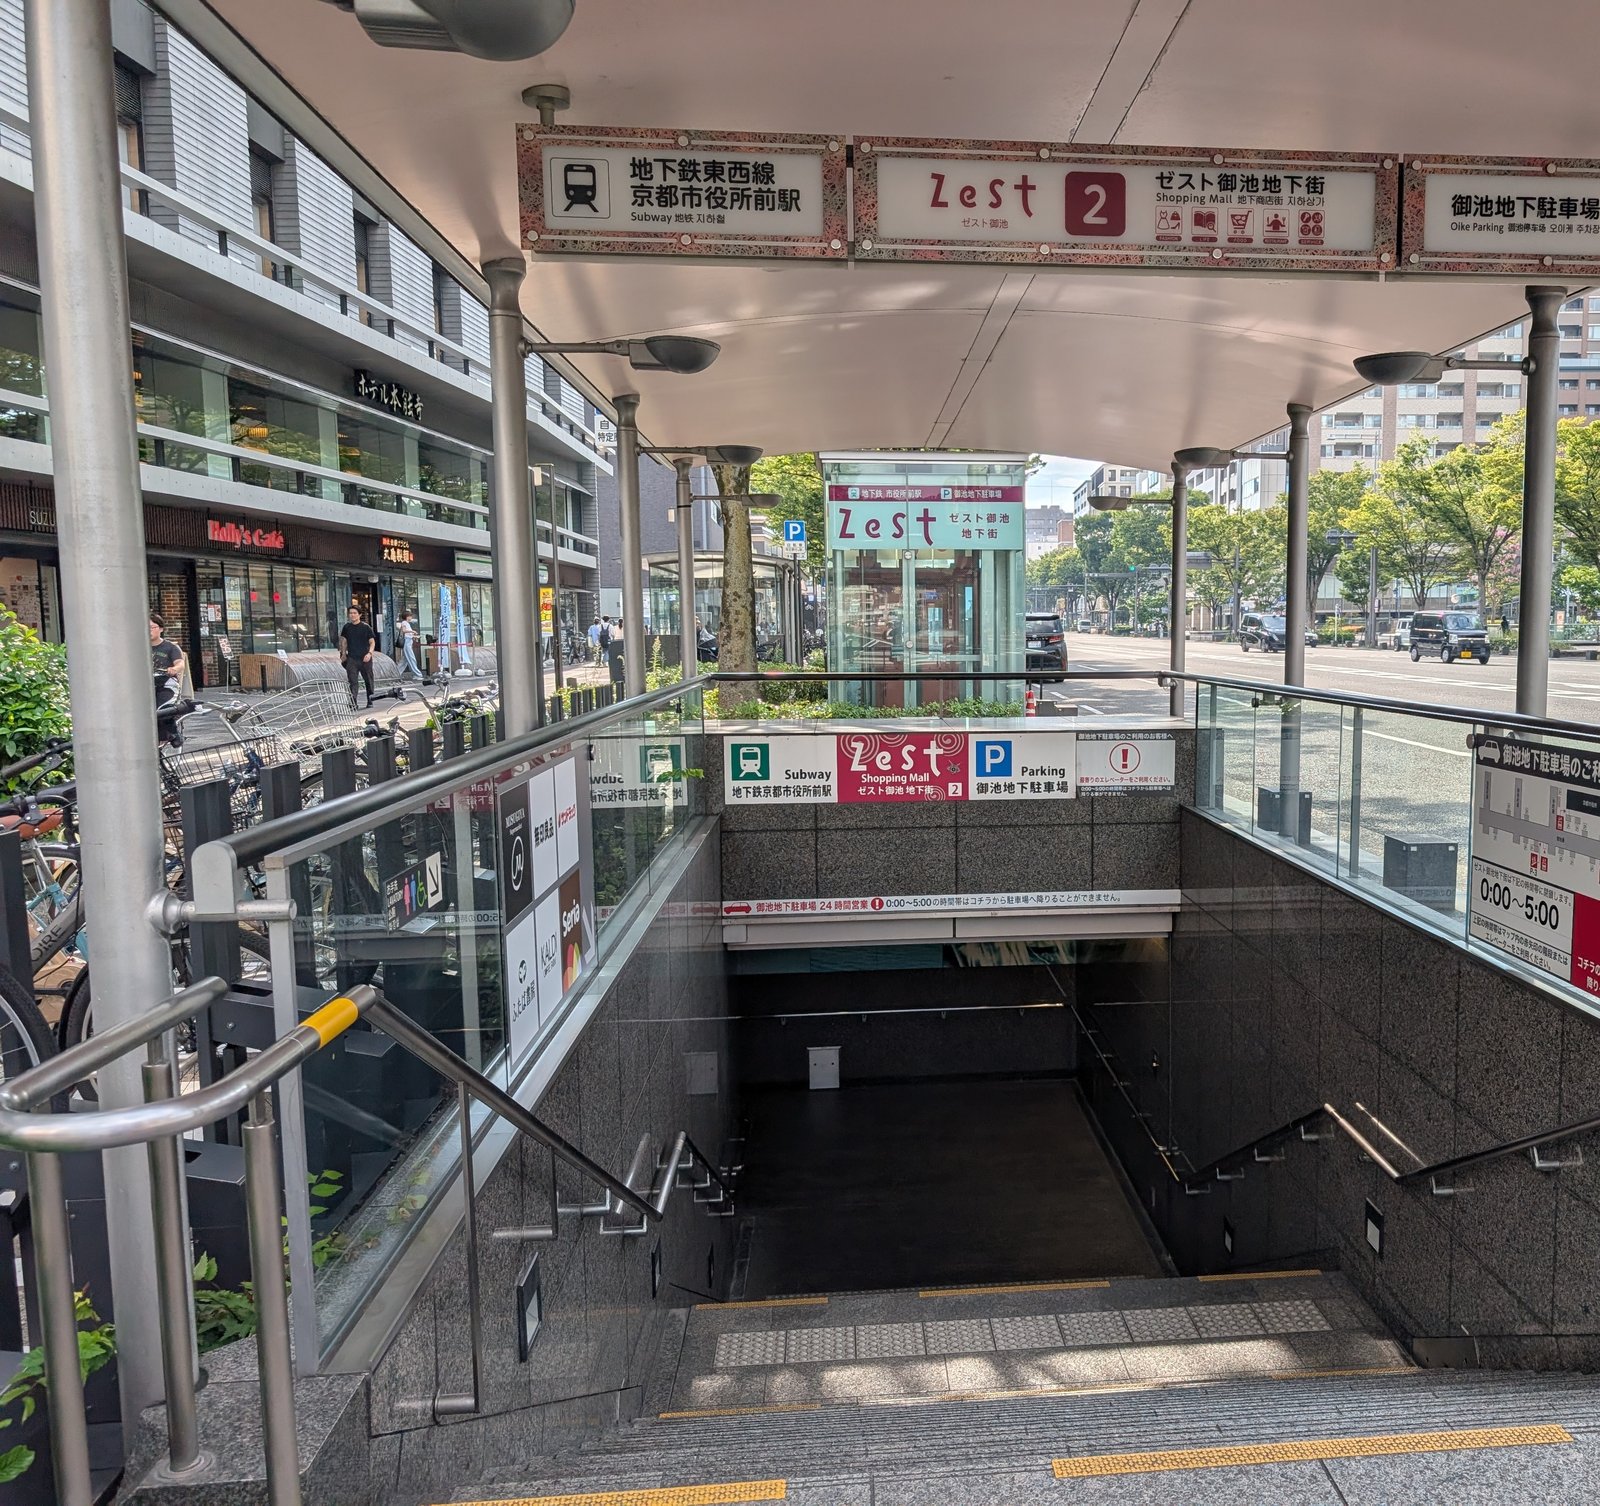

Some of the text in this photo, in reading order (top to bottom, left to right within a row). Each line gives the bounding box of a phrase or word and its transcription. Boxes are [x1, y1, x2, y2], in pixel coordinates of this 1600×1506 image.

[629, 156, 775, 185] 地下鉄東西線
[1155, 171, 1325, 195] ゼスト御池地下街
[630, 184, 801, 213] 京都市役所前駅
[930, 172, 1036, 218] Zest
[1156, 192, 1206, 205] Shopping
[1209, 194, 1233, 205] Mall
[1083, 184, 1108, 225] 2
[1451, 194, 1600, 220] 御池地下駐車場
[630, 211, 672, 224] Subway
[696, 213, 726, 225] 지하철
[961, 218, 1009, 229] ゼスト御池
[1450, 222, 1471, 232] Oike
[1473, 222, 1504, 234] Parking
[861, 489, 883, 498] 地下鉄
[949, 513, 1010, 524] ゼスト御池
[207, 520, 252, 548] Holly's
[839, 508, 937, 547] Zest
[961, 528, 999, 539] 地下街
[850, 740, 944, 777] Zest
[784, 769, 832, 782] Subway
[861, 772, 929, 784] Shopping Mall
[1021, 766, 1066, 778] Parking
[732, 785, 832, 799] 地下鉄京都市役所前駅
[857, 786, 904, 796] ゼスト御池
[951, 784, 960, 795] 2
[976, 781, 1069, 795] 御池地下駐車場
[756, 899, 869, 913] 御池地下駐車場 24 時間営業
[562, 899, 580, 938] Seria
